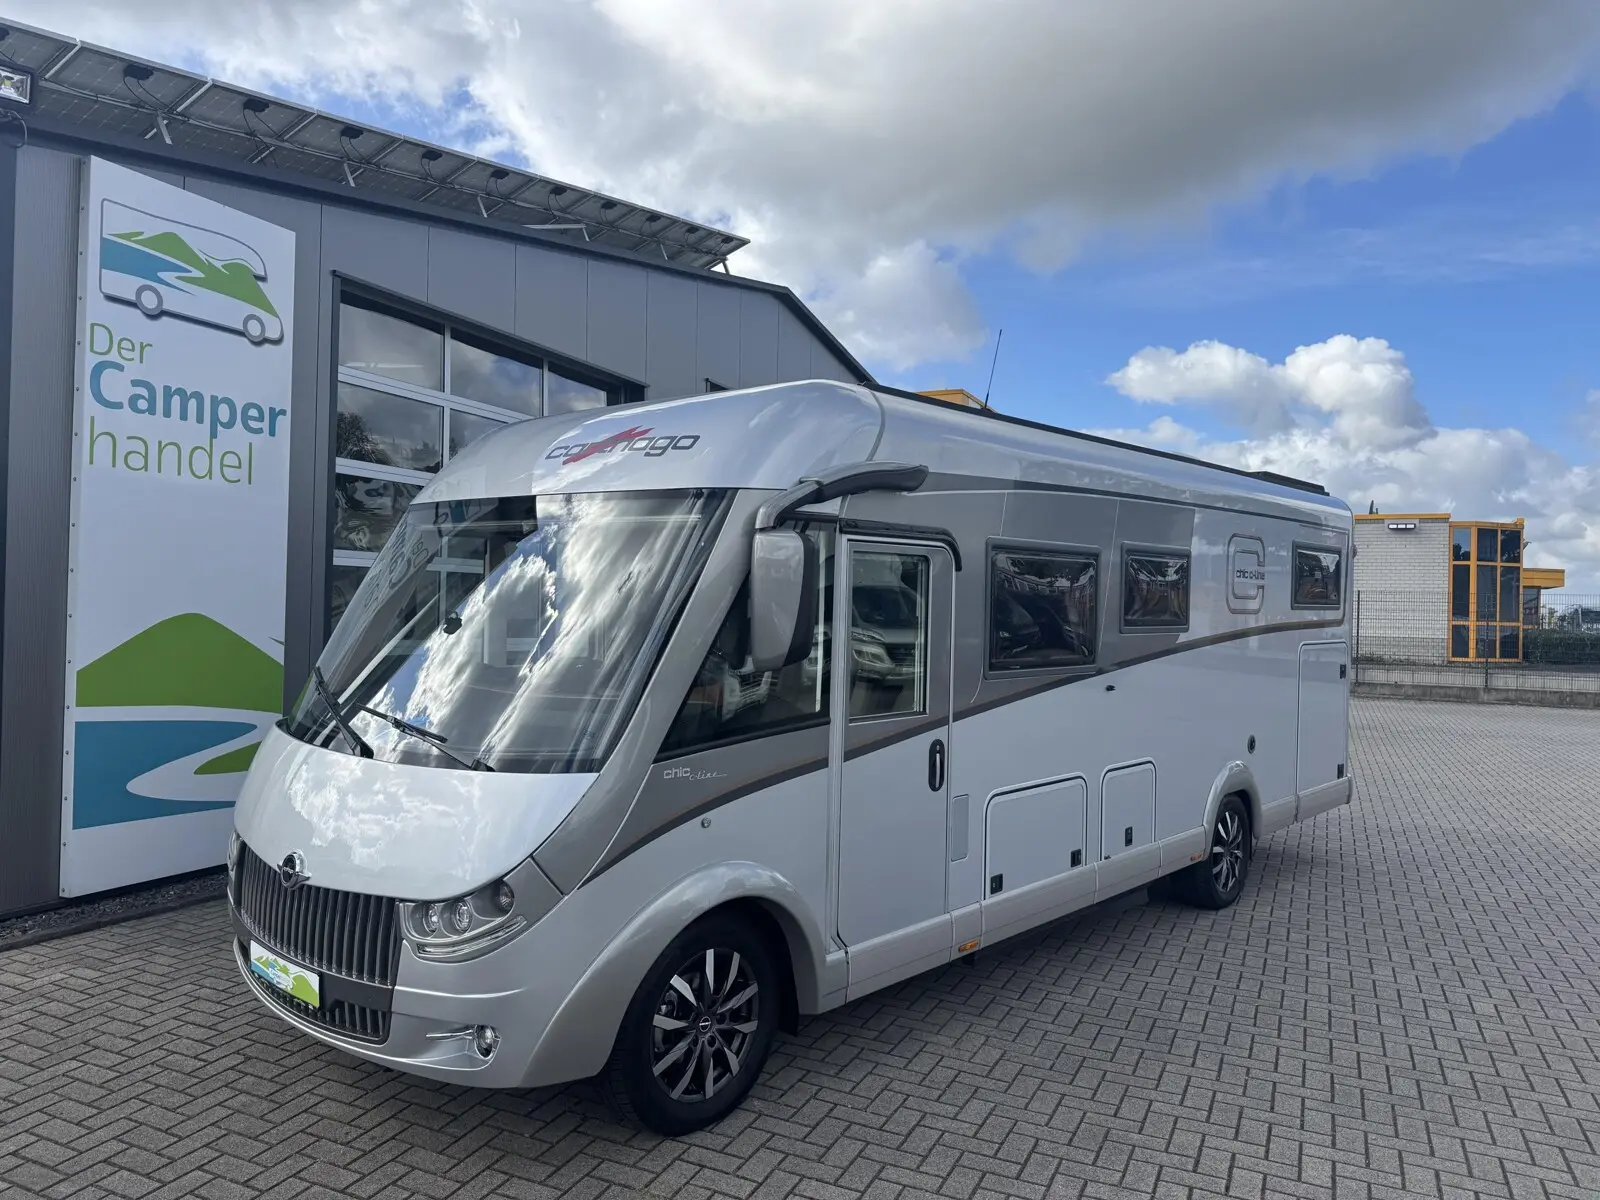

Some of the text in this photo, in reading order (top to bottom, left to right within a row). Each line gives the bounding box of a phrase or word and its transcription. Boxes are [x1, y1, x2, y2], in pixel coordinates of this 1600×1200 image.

[89, 322, 153, 364] Der
[89, 360, 287, 440] Camper
[88, 415, 253, 486] handel
[663, 766, 691, 779] chic
